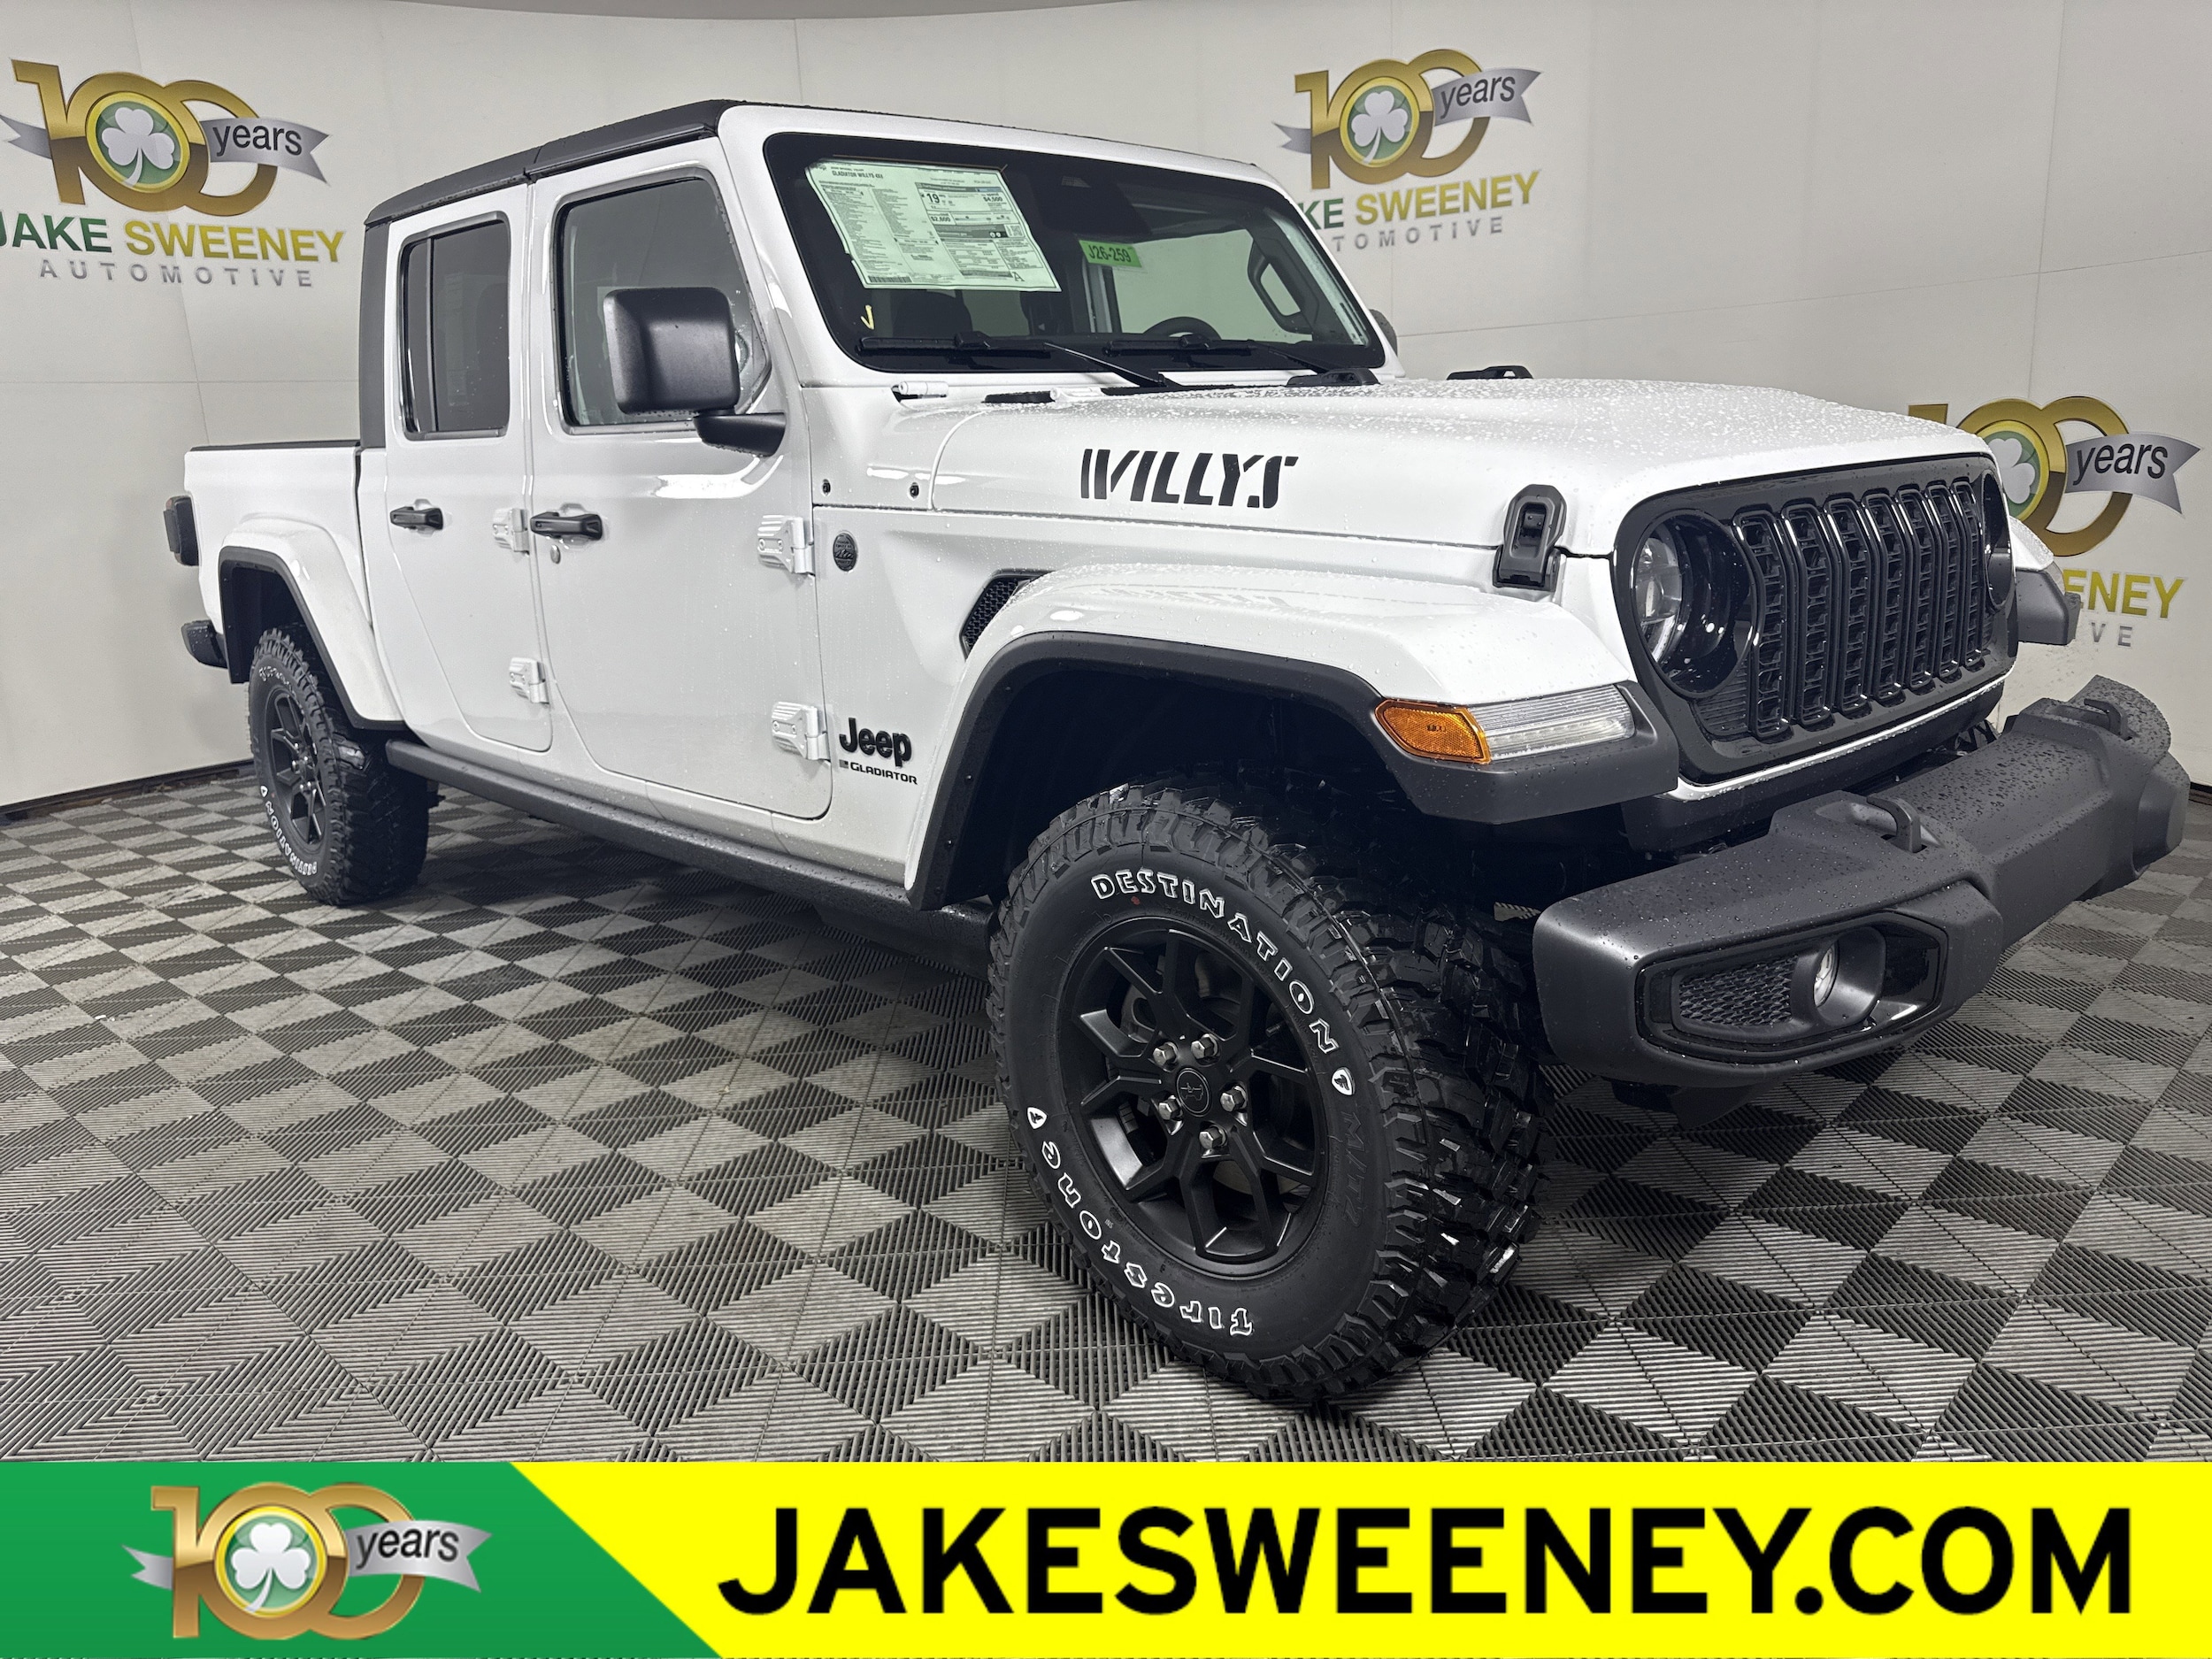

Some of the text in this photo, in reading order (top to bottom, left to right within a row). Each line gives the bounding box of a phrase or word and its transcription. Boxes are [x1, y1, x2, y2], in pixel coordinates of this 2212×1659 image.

[1440, 76, 1516, 119] years
[211, 125, 303, 157] years
[926, 194, 941, 204] 19
[1356, 171, 1539, 226] SWEENEY
[124, 220, 344, 263] SWEENEY
[1088, 244, 1132, 263] J26-259
[1332, 217, 1502, 252] TOMOTIVE
[40, 259, 312, 288] AUTOMOTIVE
[1080, 449, 1299, 509] WILLYS
[2073, 443, 2168, 486] years
[839, 718, 912, 768] Jeep
[850, 762, 918, 786] GLADIATOR
[1091, 868, 1340, 1054] DESTINATION
